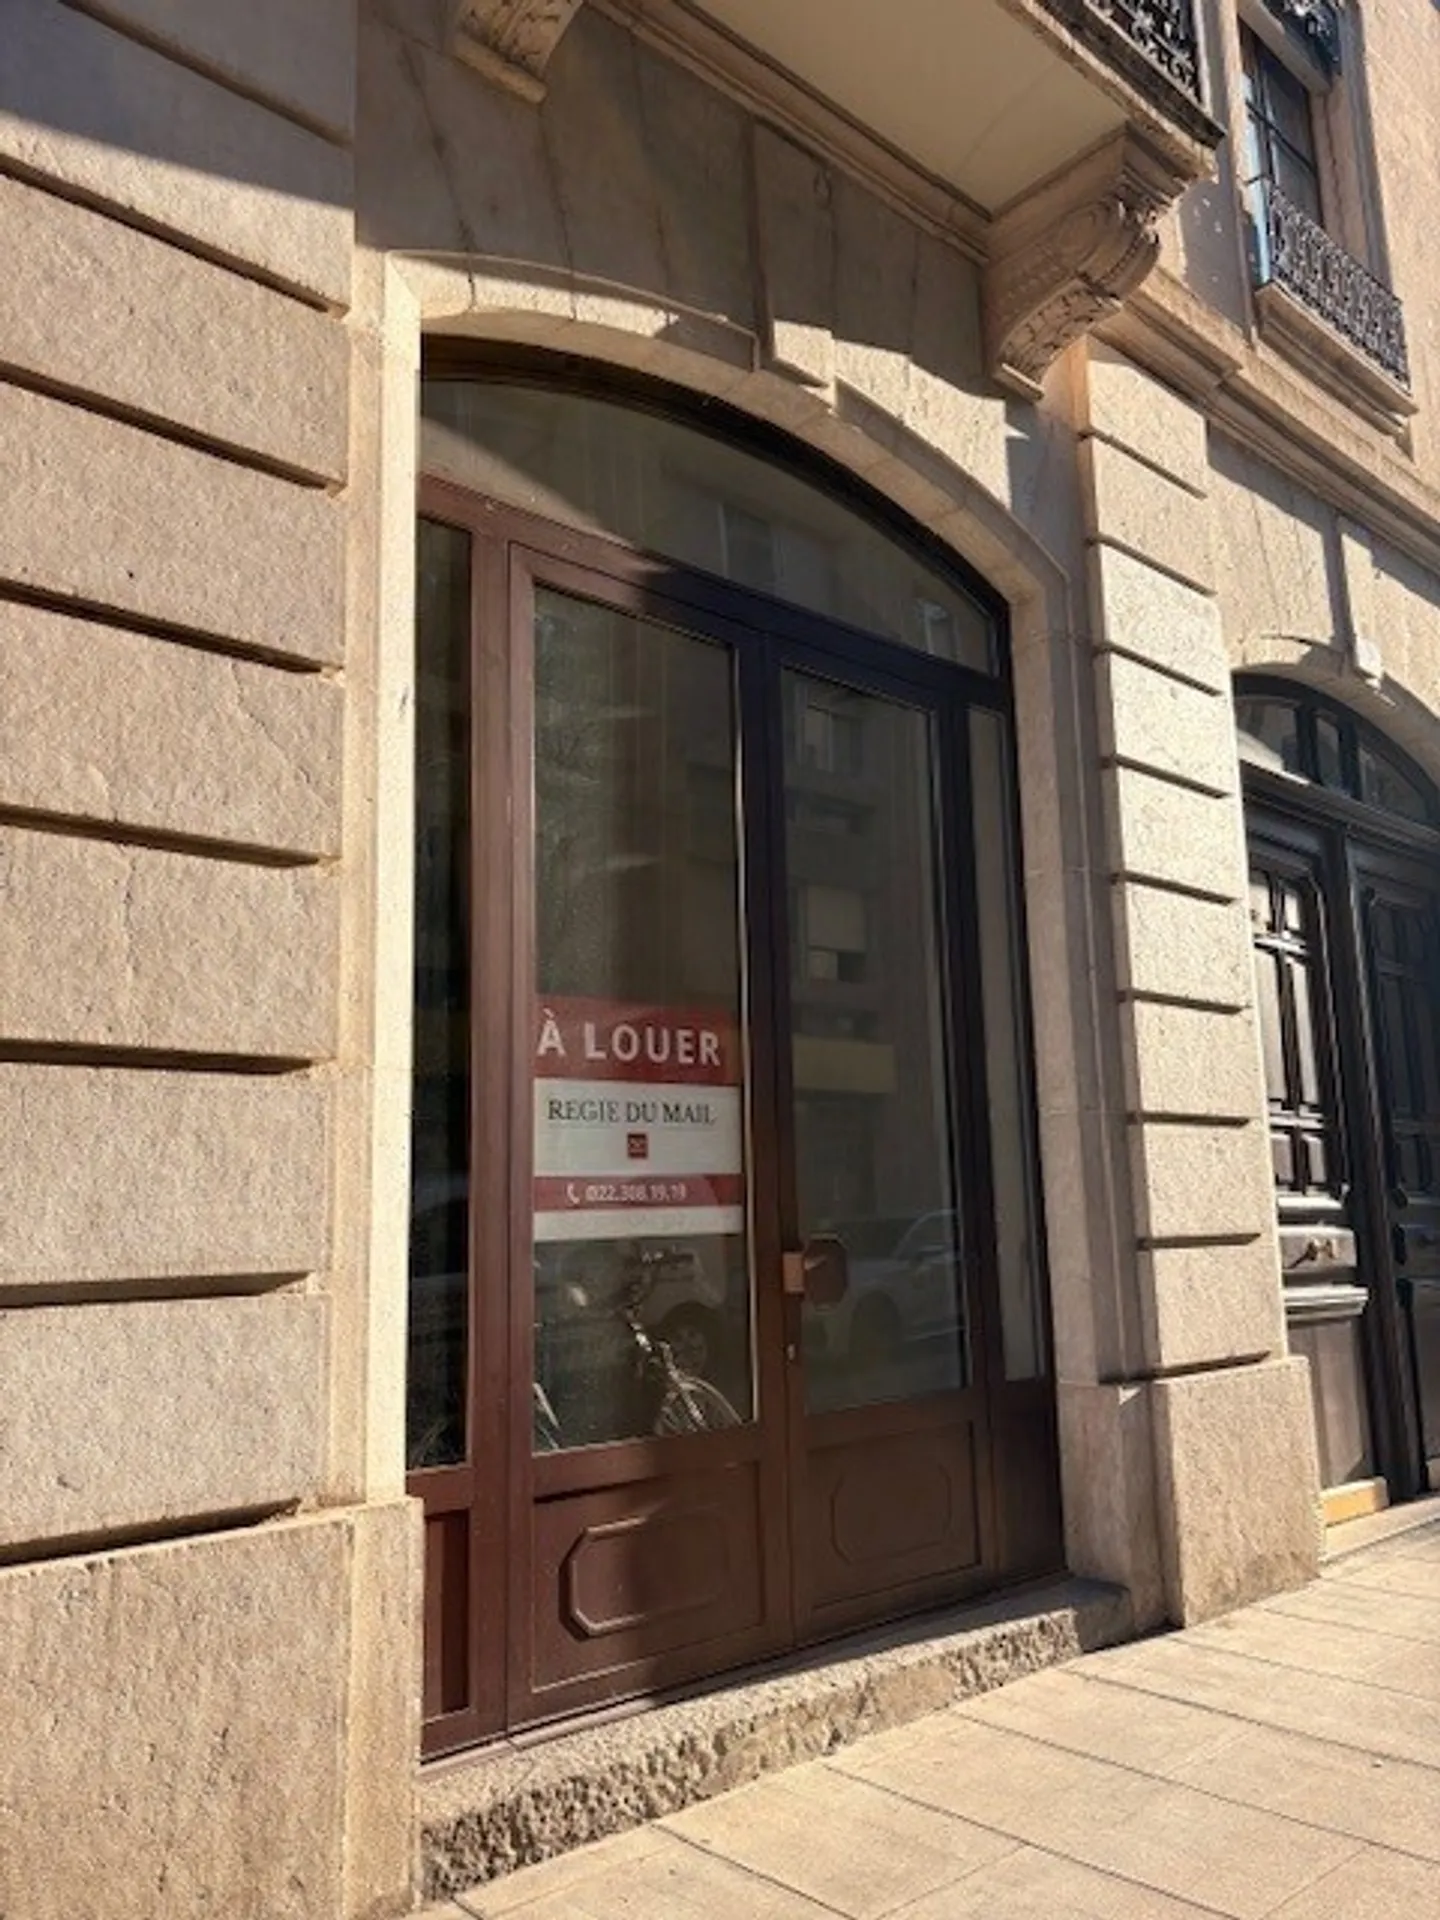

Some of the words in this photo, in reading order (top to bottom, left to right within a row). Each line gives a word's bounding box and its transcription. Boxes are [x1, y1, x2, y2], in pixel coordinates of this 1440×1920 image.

[538, 1008, 566, 1056] À
[585, 1023, 721, 1066] LOUER
[548, 1100, 620, 1122] REGIE
[625, 1101, 656, 1123] DU
[662, 1102, 716, 1126] MAIL
